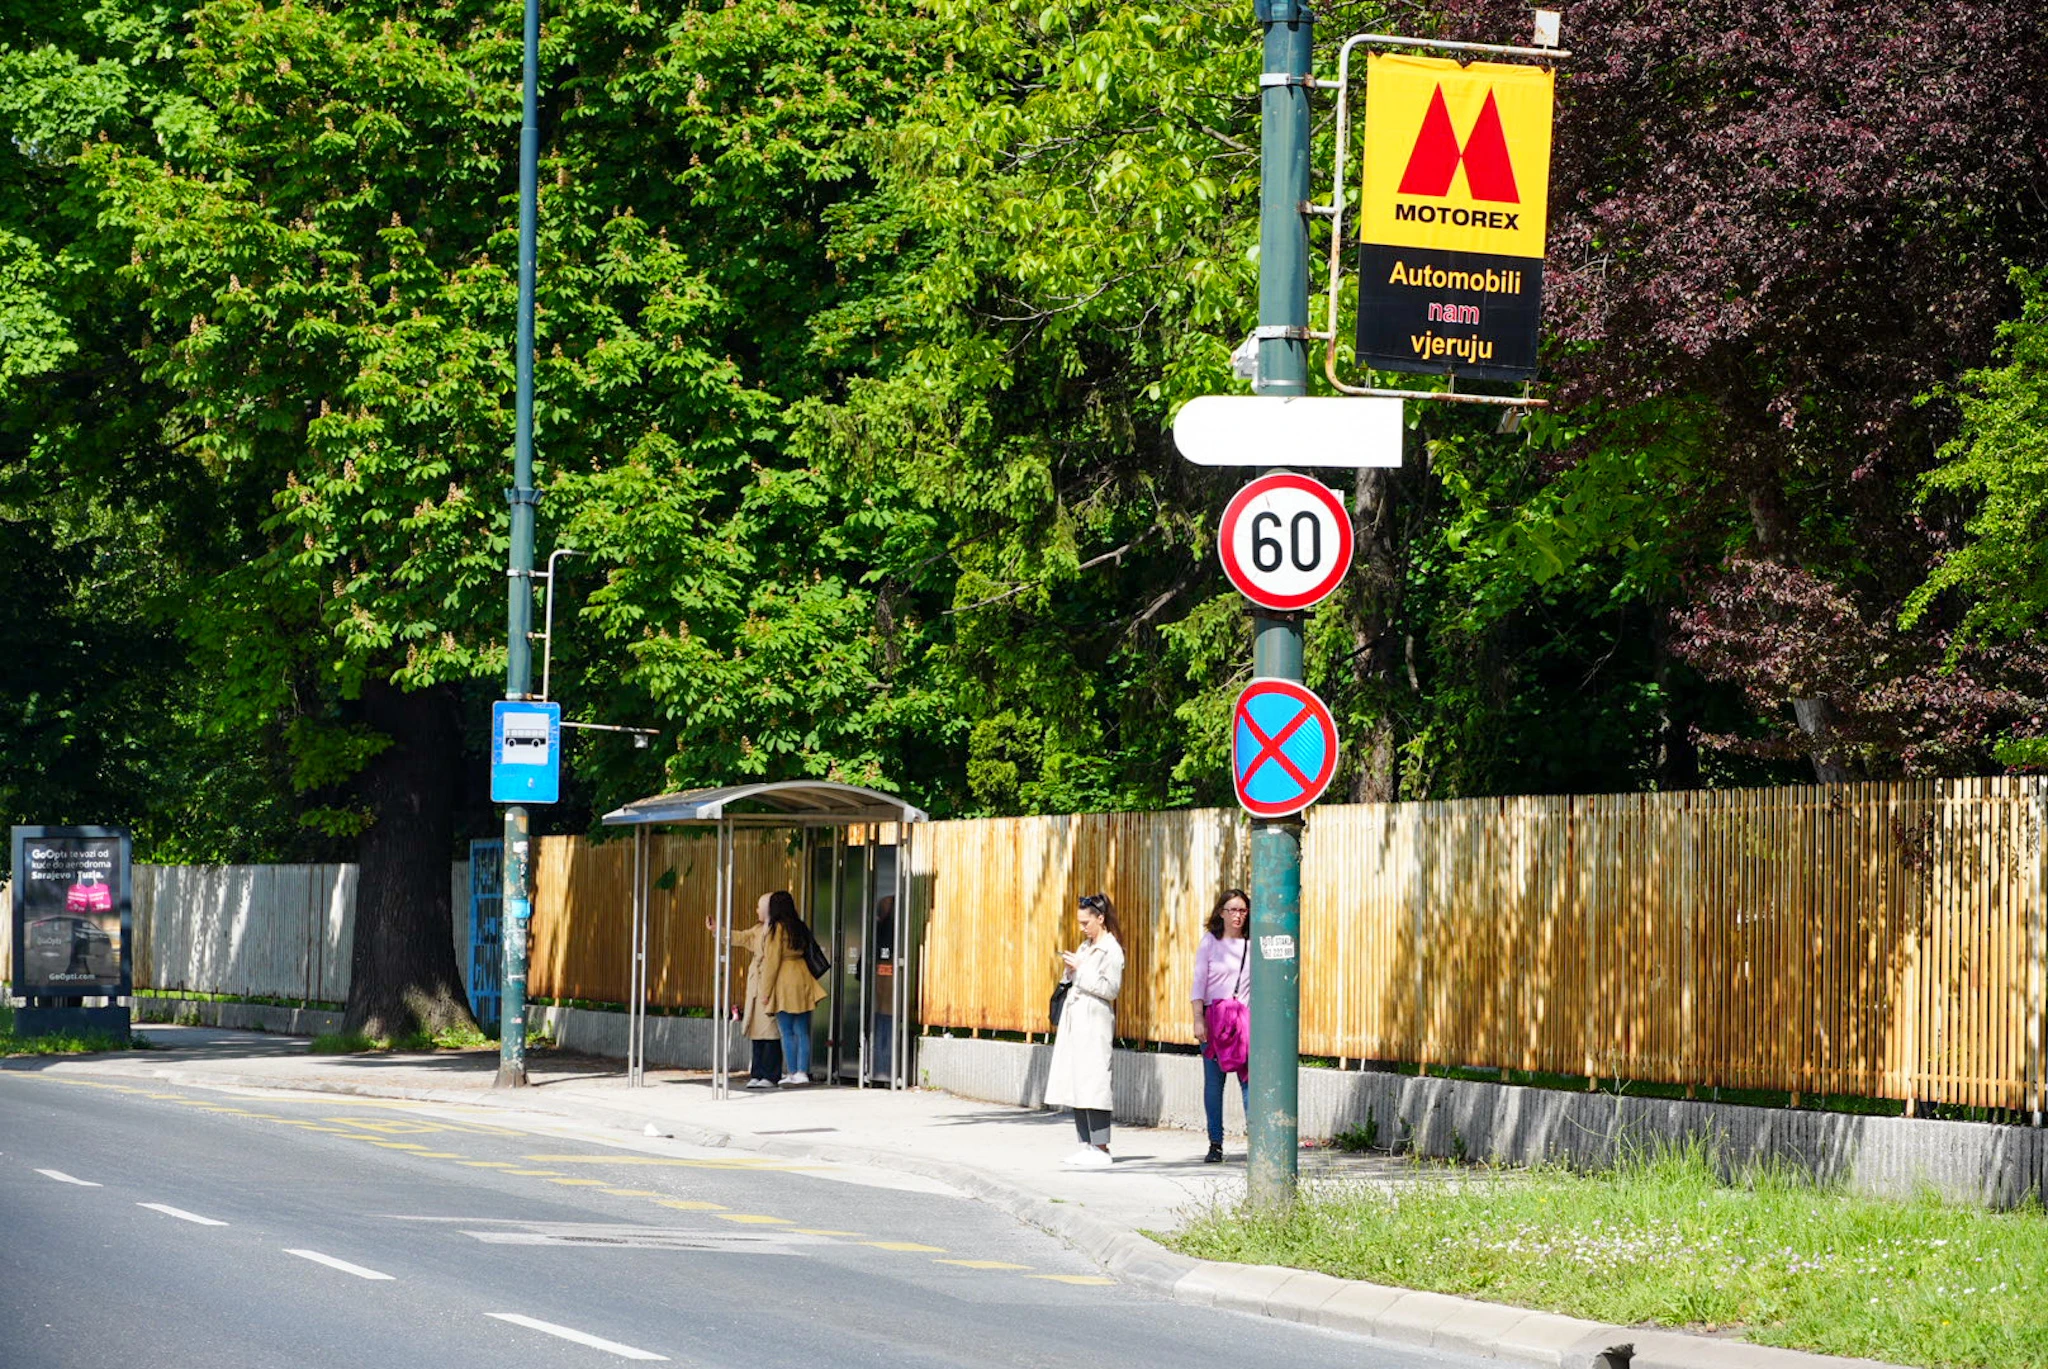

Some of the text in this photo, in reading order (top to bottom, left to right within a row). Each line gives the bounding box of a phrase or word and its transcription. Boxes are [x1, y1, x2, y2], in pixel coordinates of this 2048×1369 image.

[1395, 204, 1519, 231] MOTOREX
[1389, 260, 1521, 295] Automobili
[1428, 302, 1480, 325] nam
[1410, 330, 1493, 363] vjeruju
[1251, 510, 1321, 573] 60
[31, 849, 67, 861] GoOpti
[80, 849, 96, 858] vozi
[97, 849, 109, 858] od
[53, 860, 64, 869] do
[65, 860, 112, 869] aerodroma
[31, 871, 71, 880] Sarajevo
[48, 972, 96, 982] GoOpti.com
